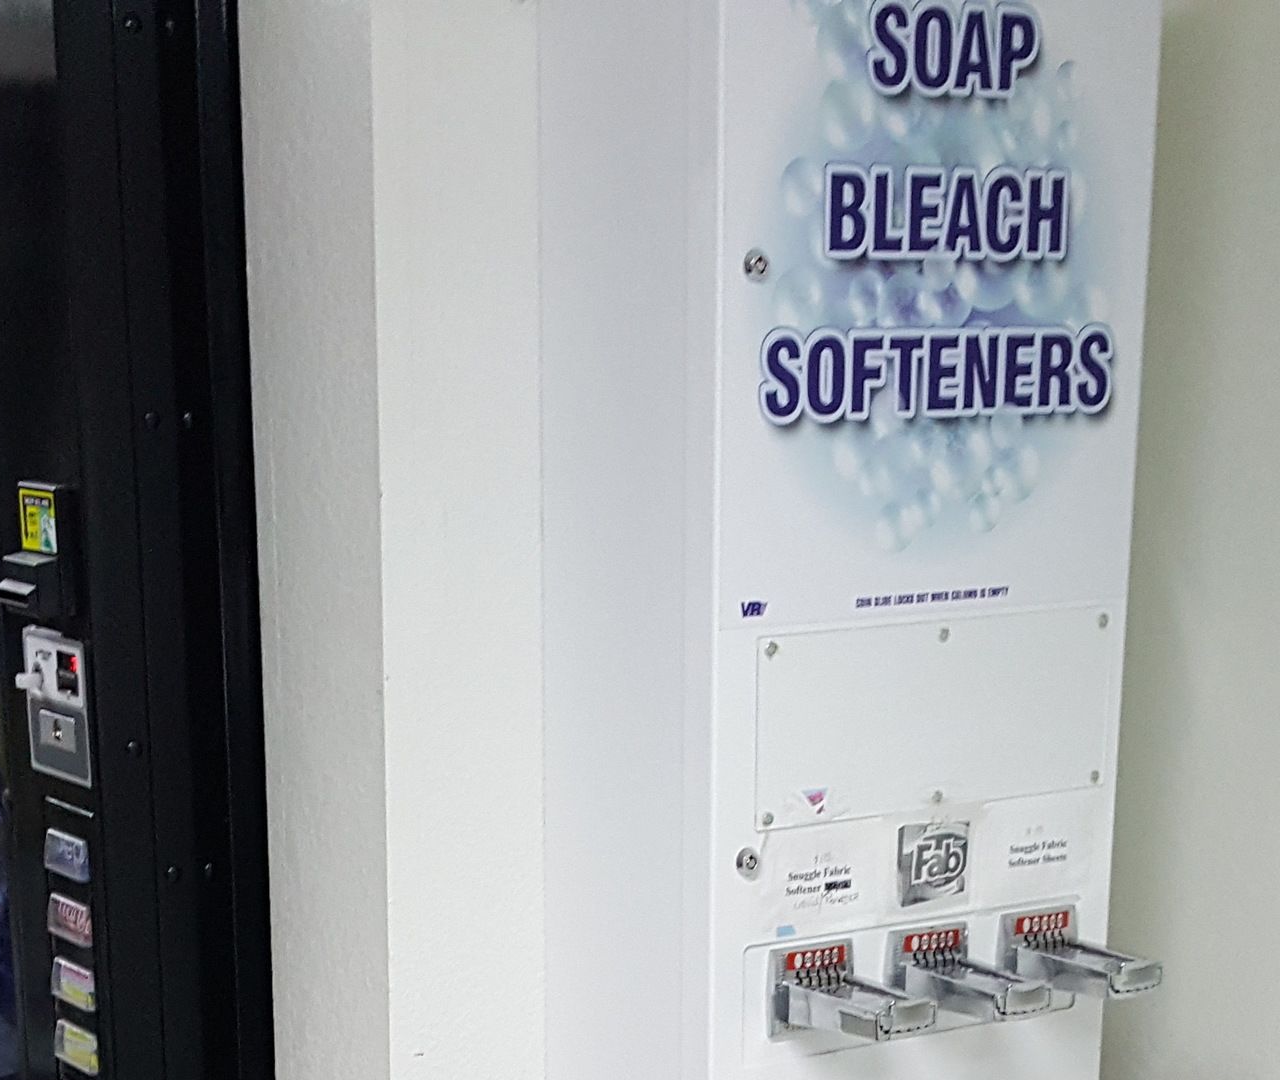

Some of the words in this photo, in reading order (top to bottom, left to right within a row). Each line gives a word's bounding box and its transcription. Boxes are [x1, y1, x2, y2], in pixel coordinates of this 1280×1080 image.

[871, 3, 1037, 91] SOAP
[826, 171, 1067, 257] BLEACH
[764, 330, 1113, 418] SOFTENERS
[912, 838, 963, 884] Fab
